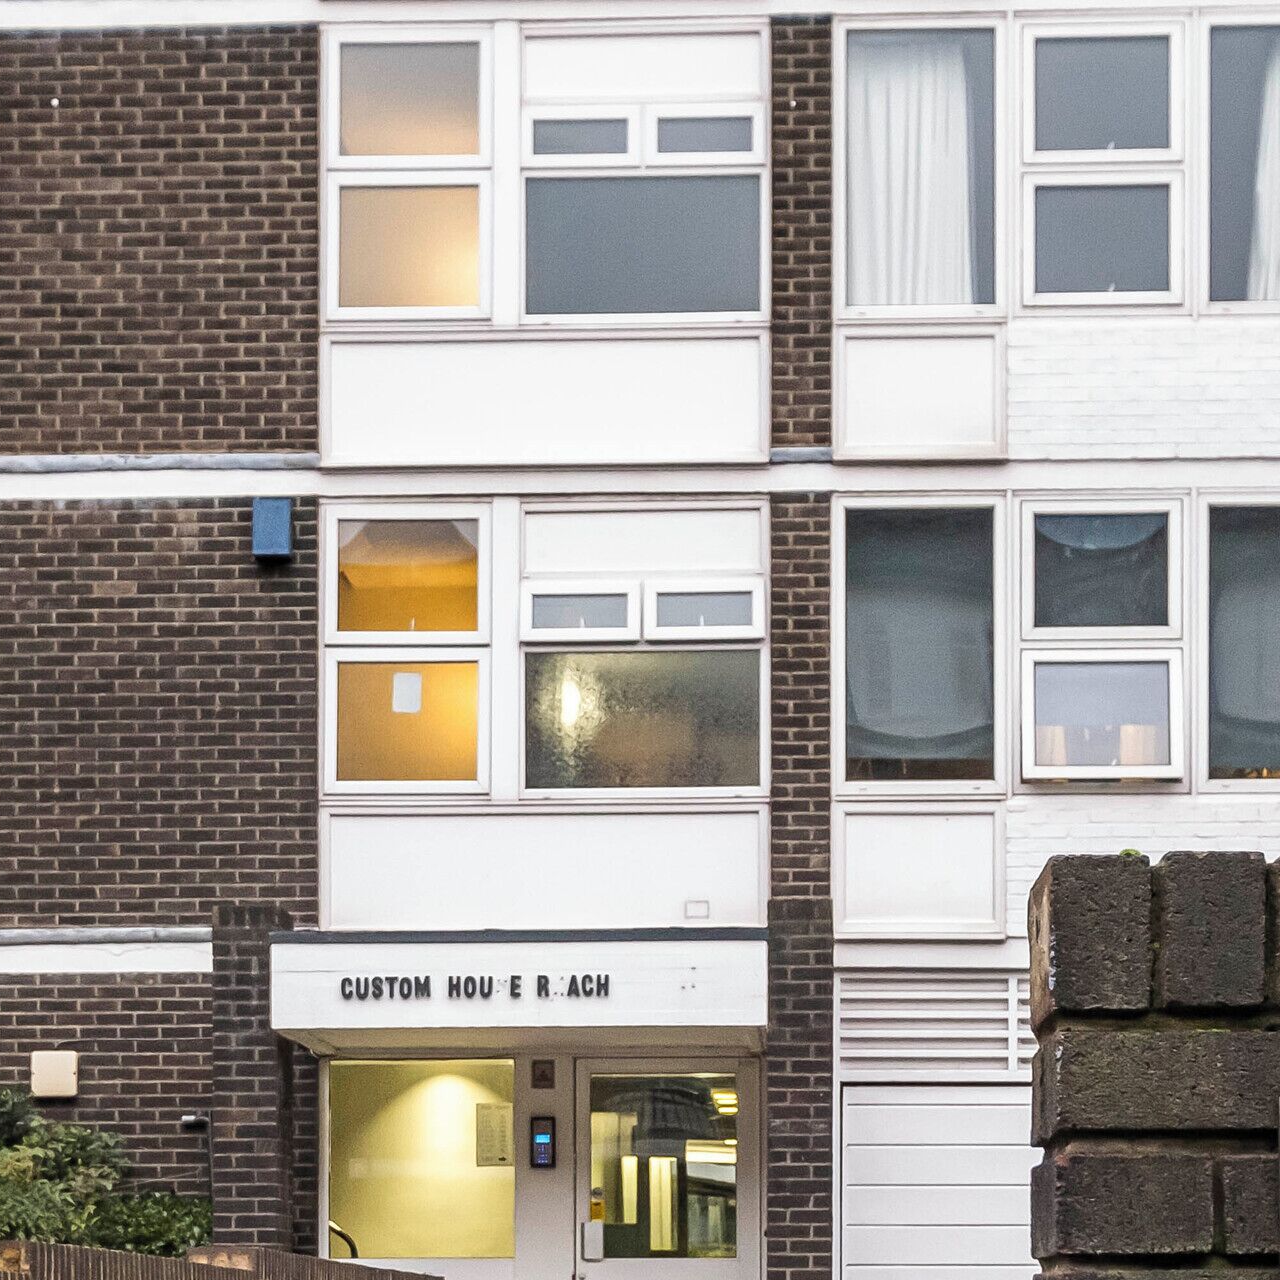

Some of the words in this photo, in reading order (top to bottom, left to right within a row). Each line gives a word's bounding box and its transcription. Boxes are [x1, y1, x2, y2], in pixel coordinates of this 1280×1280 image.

[340, 975, 431, 1001] CUSTOM
[448, 975, 522, 1000] HOUE
[536, 974, 610, 999] RACH
